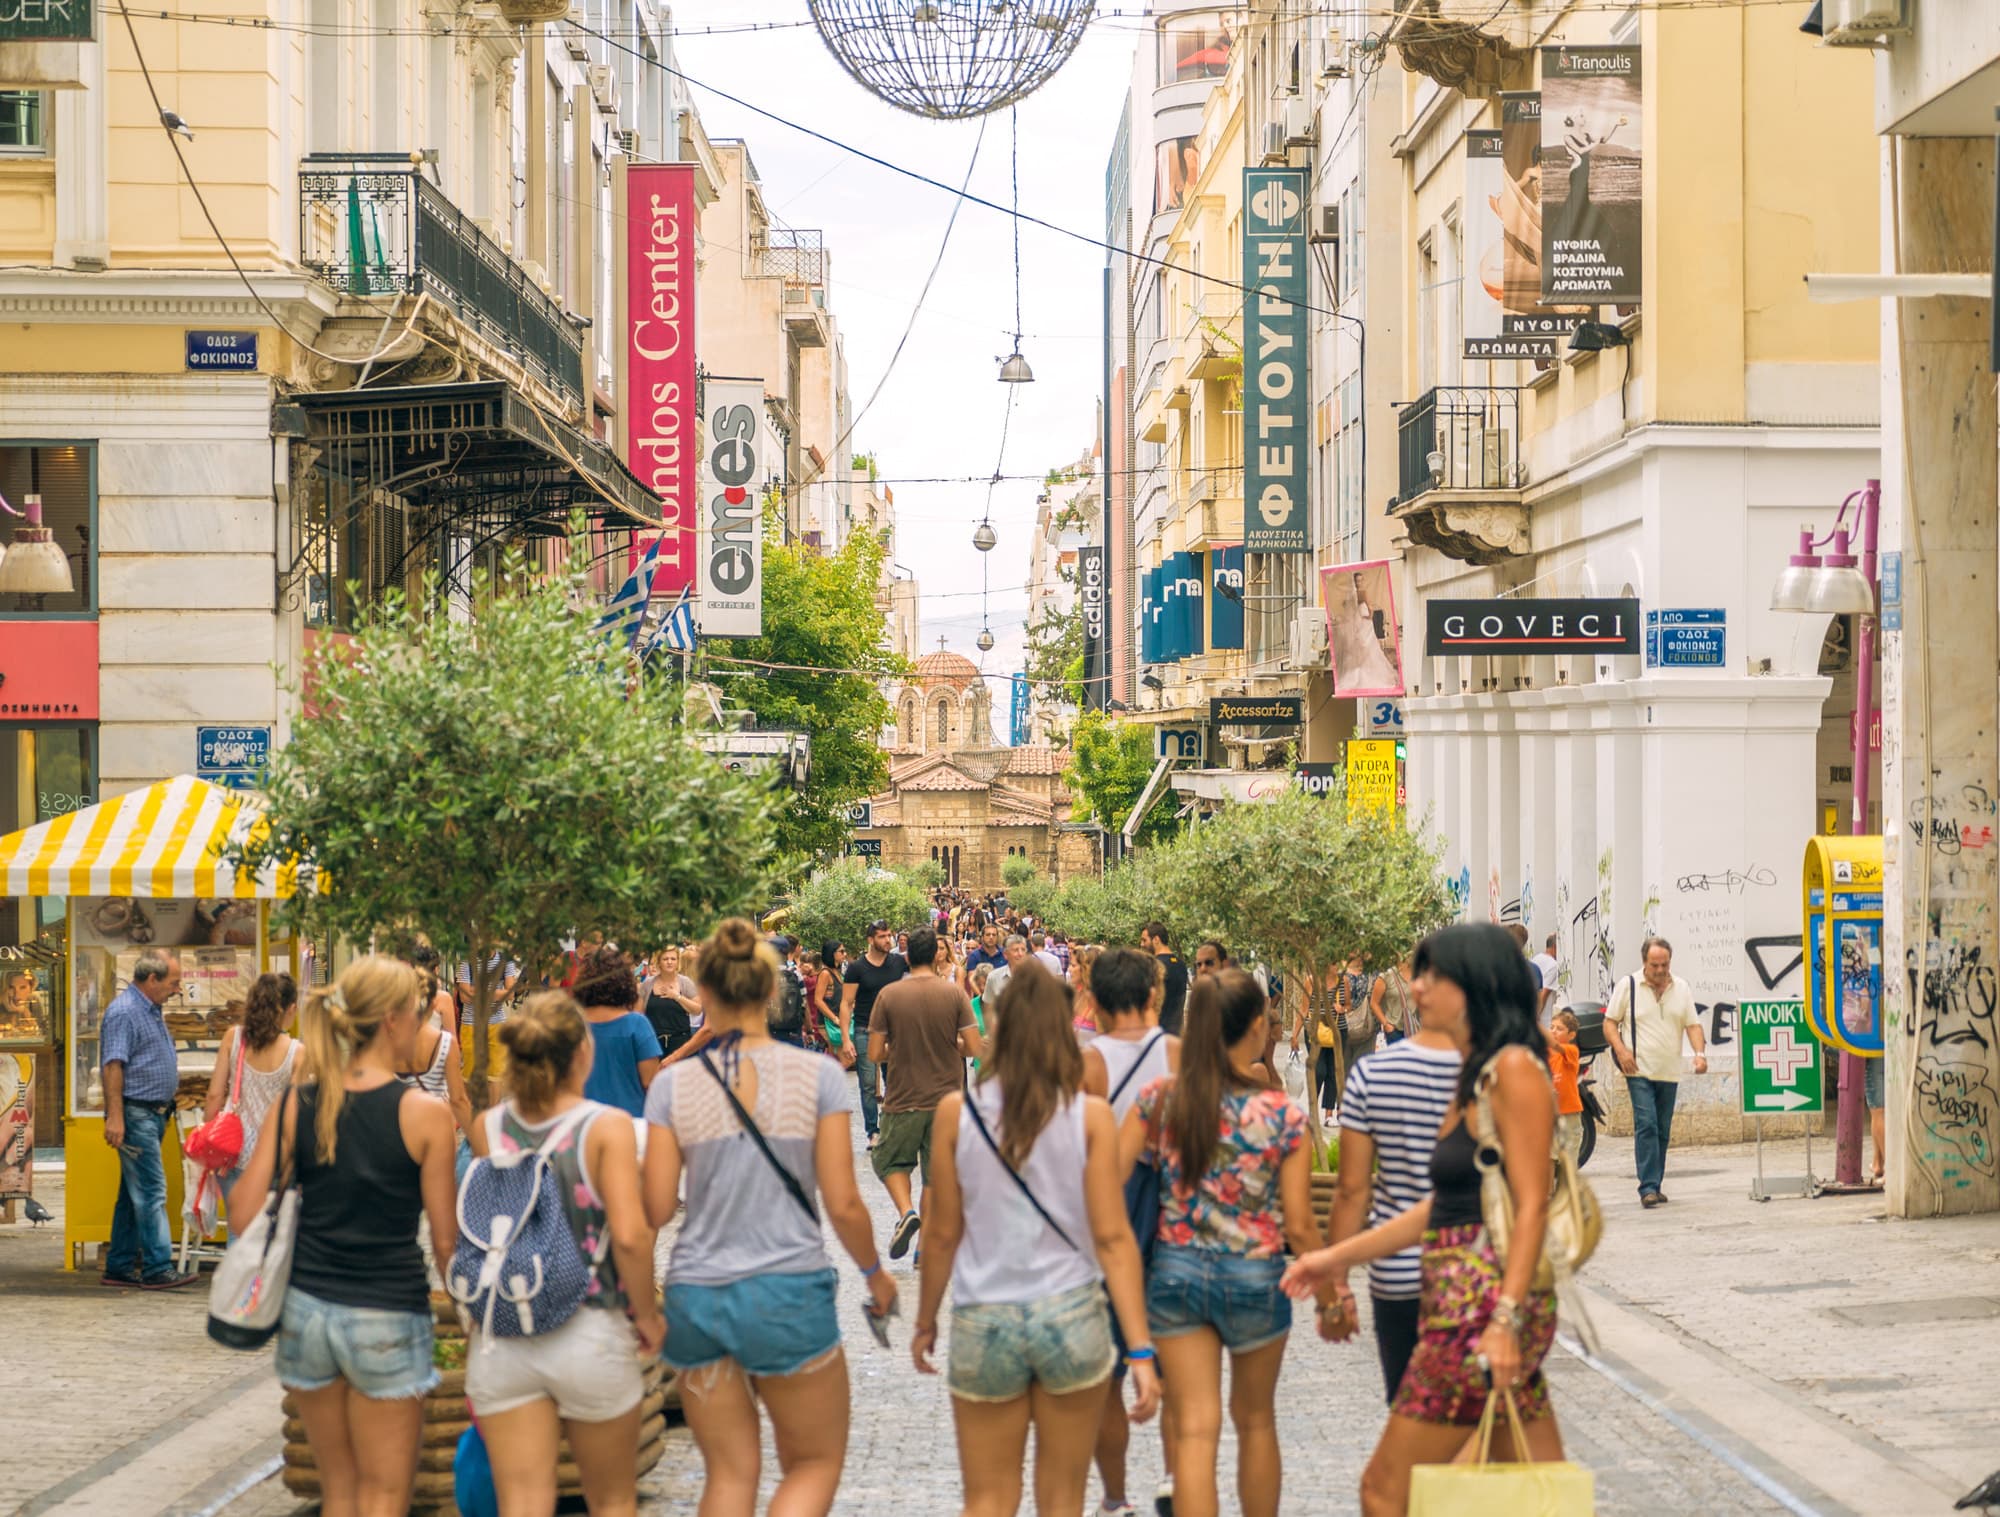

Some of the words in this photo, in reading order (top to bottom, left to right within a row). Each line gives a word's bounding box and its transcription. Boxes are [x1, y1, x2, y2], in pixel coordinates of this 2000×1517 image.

[1570, 53, 1631, 69] Tranoulis
[1552, 240, 1600, 250] ΝΥΦΙΚΑ
[1552, 253, 1606, 263] ΒΡΑΔΙΝΑ
[1552, 266, 1624, 277] ΚΟΣΤΟΥΜΙΑ
[634, 194, 680, 361] Center
[1552, 280, 1612, 290] ΑΡΩΜΑΤΑ
[207, 335, 237, 347] ΟΔΟΣ
[1468, 343, 1552, 354] ΑΡΩΜΑΤΑ
[190, 352, 254, 364] ΦΩΚΙΩΝΟΣ
[1258, 241, 1294, 527] ΦΕΤΟΥΡΗ
[1248, 530, 1304, 539] ΑΚΟΥΣΤΙΚΑ
[1083, 556, 1101, 639] adidas
[1663, 613, 1684, 622] ΑΠΟ
[1444, 615, 1622, 638] GOVECI
[1677, 630, 1709, 639] ΟΔΟΣ
[1218, 701, 1294, 720] Accessorize
[217, 730, 254, 740] ΟΔΟΣ
